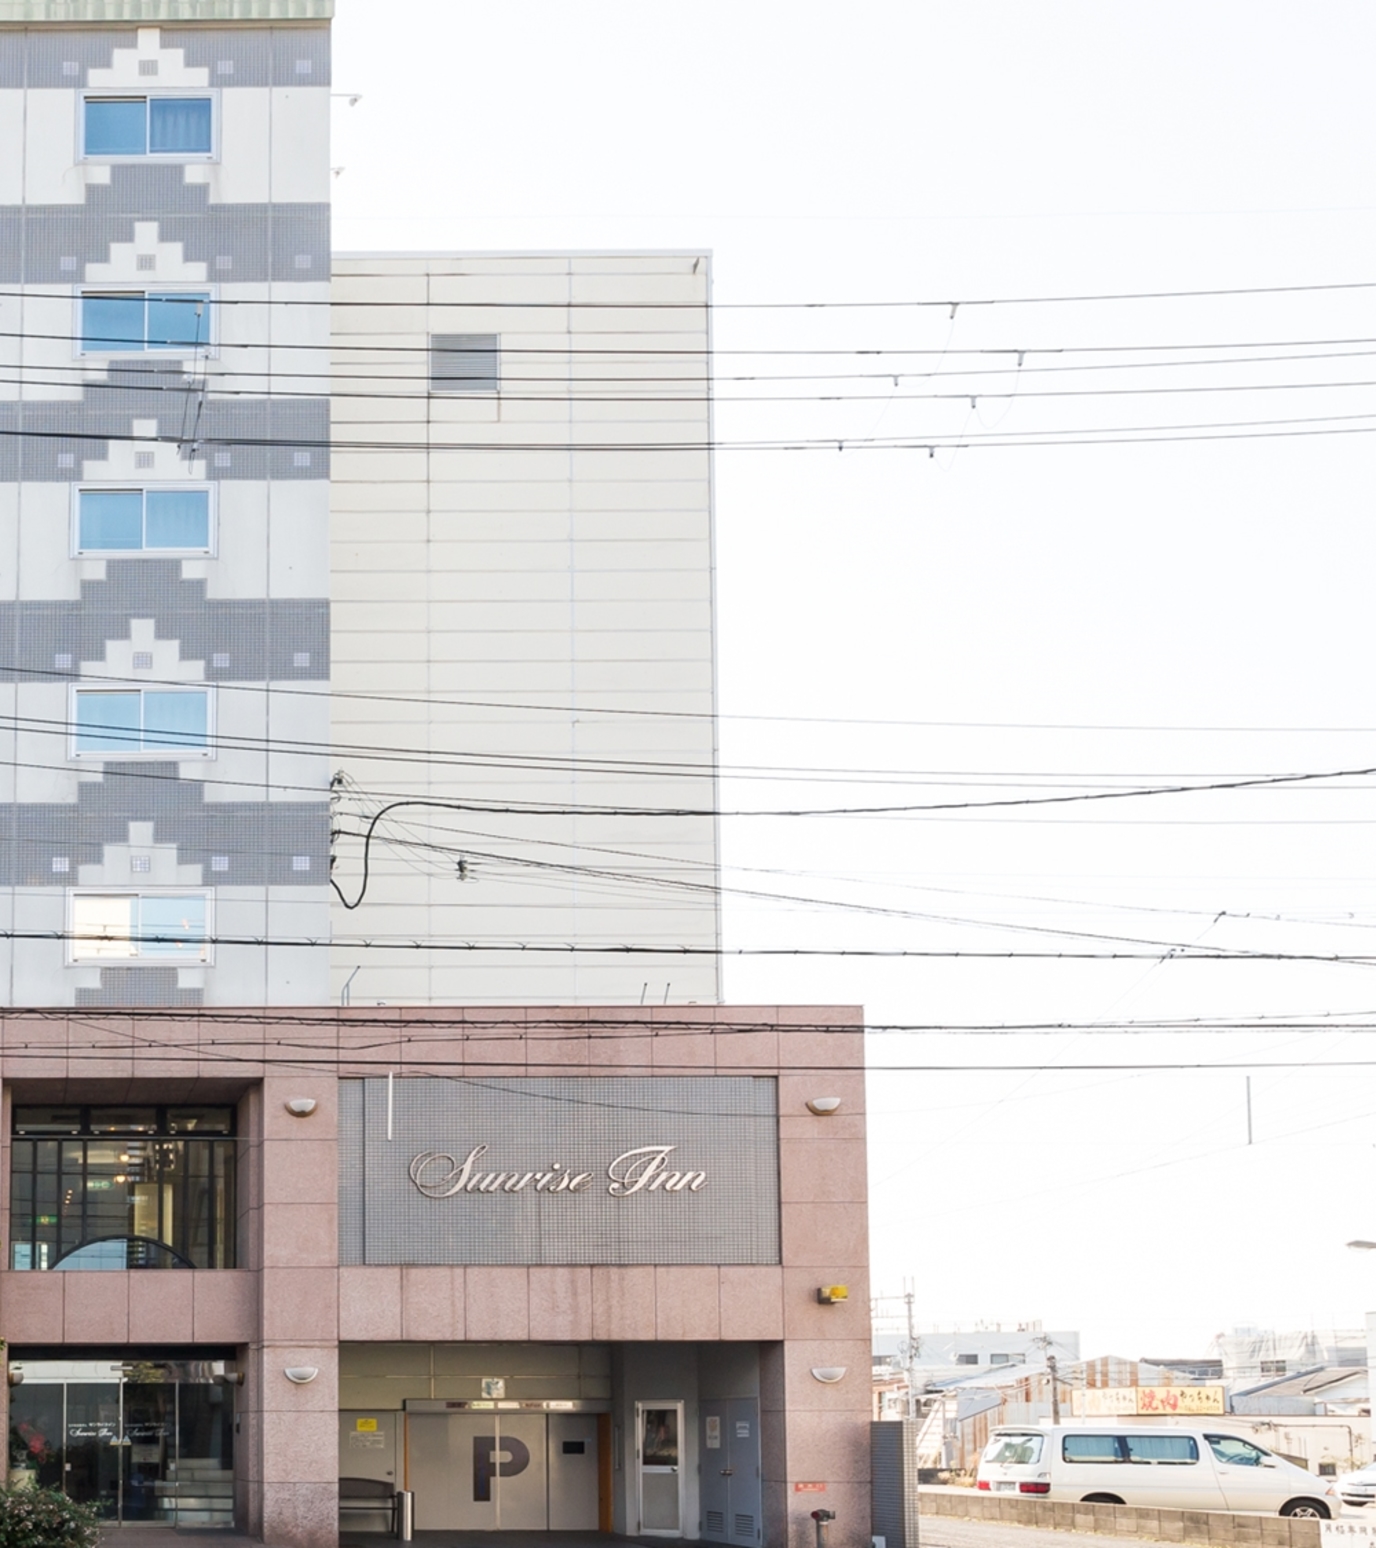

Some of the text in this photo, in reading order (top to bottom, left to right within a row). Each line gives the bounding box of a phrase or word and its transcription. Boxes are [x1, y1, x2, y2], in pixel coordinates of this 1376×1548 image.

[409, 1143, 709, 1198] Sunrise Inn
[1141, 1389, 1178, 1412] 焼肉
[473, 1436, 530, 1501] P
